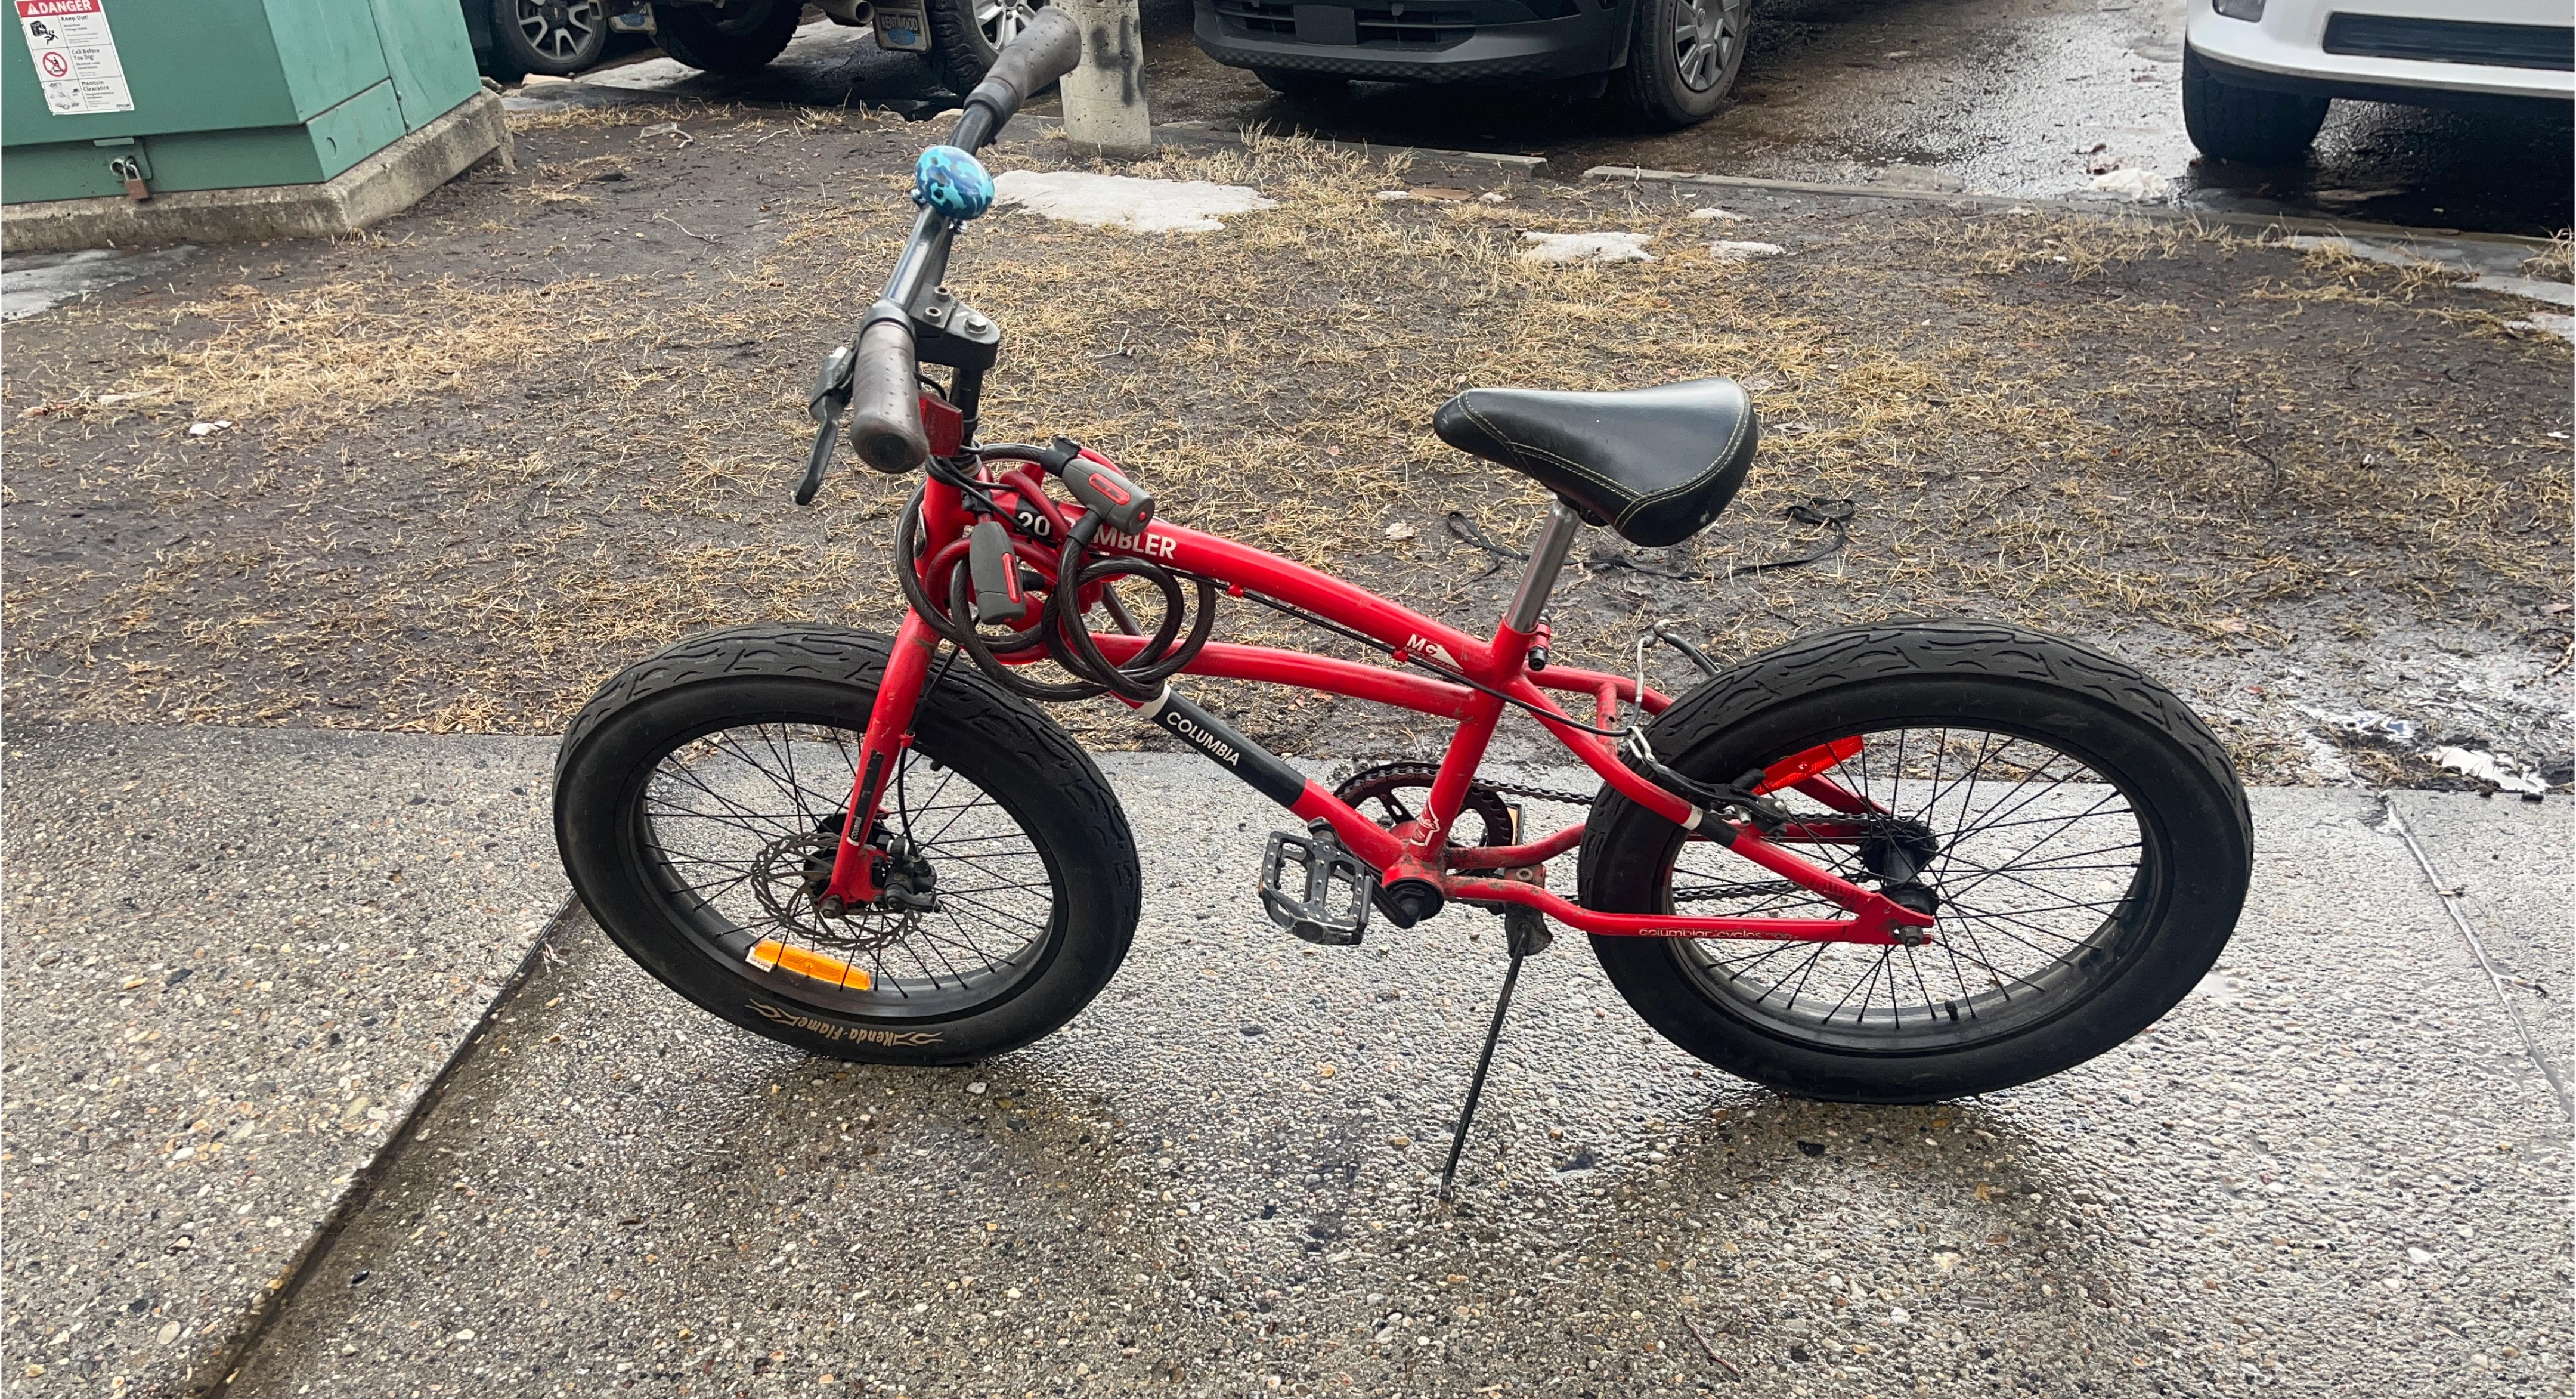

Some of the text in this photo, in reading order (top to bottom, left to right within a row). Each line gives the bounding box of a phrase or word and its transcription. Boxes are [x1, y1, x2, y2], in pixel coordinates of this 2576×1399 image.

[38, 0, 92, 14] DANGER
[1166, 711, 1240, 766] COLUMBIA
[799, 1016, 895, 1047] Kenda Flame
